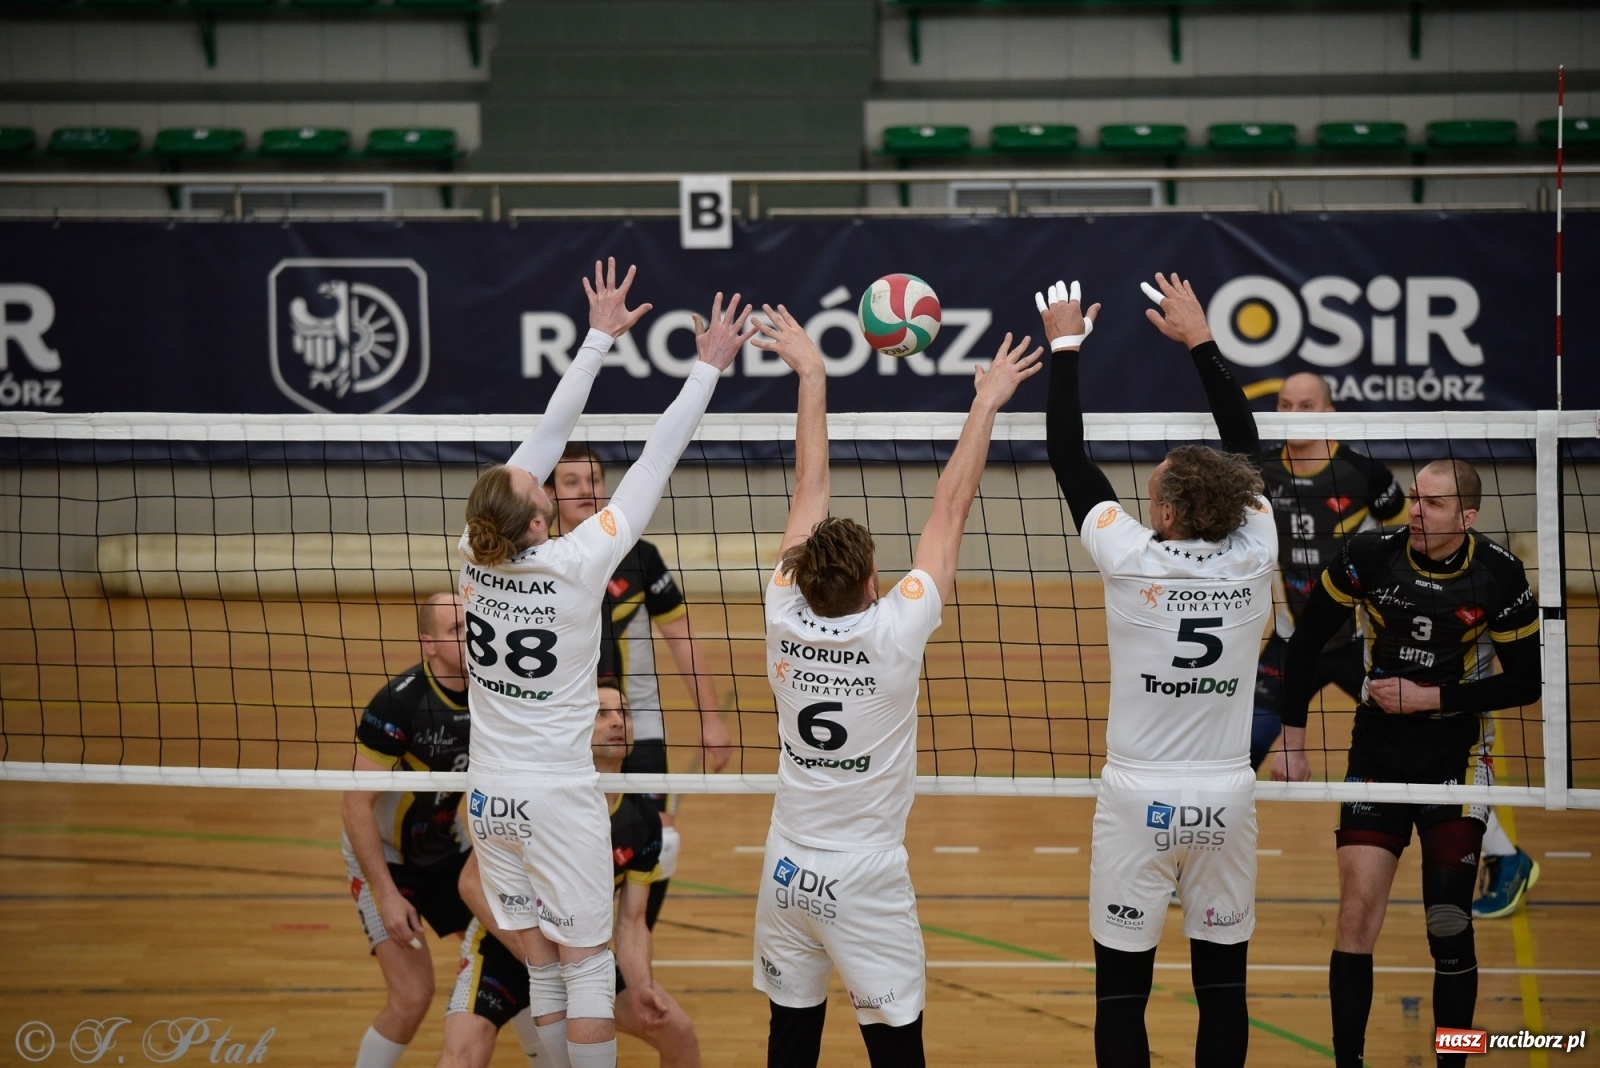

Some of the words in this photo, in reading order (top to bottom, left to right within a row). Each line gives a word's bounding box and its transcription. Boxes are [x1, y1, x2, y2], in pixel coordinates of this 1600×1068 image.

[690, 191, 724, 231] B
[1206, 274, 1485, 368] OSiR
[1290, 513, 1316, 541] 13
[465, 564, 558, 595] MICHALAK
[475, 594, 557, 616] ZOO-MAR
[1166, 598, 1252, 612] LUNATYCY
[1167, 587, 1252, 601] ZOO-MAR
[475, 604, 557, 624] LUNATYCY
[1410, 615, 1433, 641] 3
[465, 610, 558, 680] 88
[780, 640, 870, 665] SKORUPA
[1171, 616, 1224, 670] 5
[1398, 646, 1436, 668] ENTER
[792, 669, 877, 687] ZOO-MAR
[792, 681, 877, 697] LUNATYCY
[1140, 673, 1239, 698] TropiDog
[797, 701, 848, 751] 6
[490, 796, 531, 821] DK
[1179, 805, 1227, 828] DK
[473, 814, 533, 841] glass
[1154, 825, 1226, 852] glass
[798, 868, 840, 902] DK
[775, 885, 837, 919] glass
[1106, 914, 1144, 926] wepol
[857, 987, 895, 1009] kolgraf
